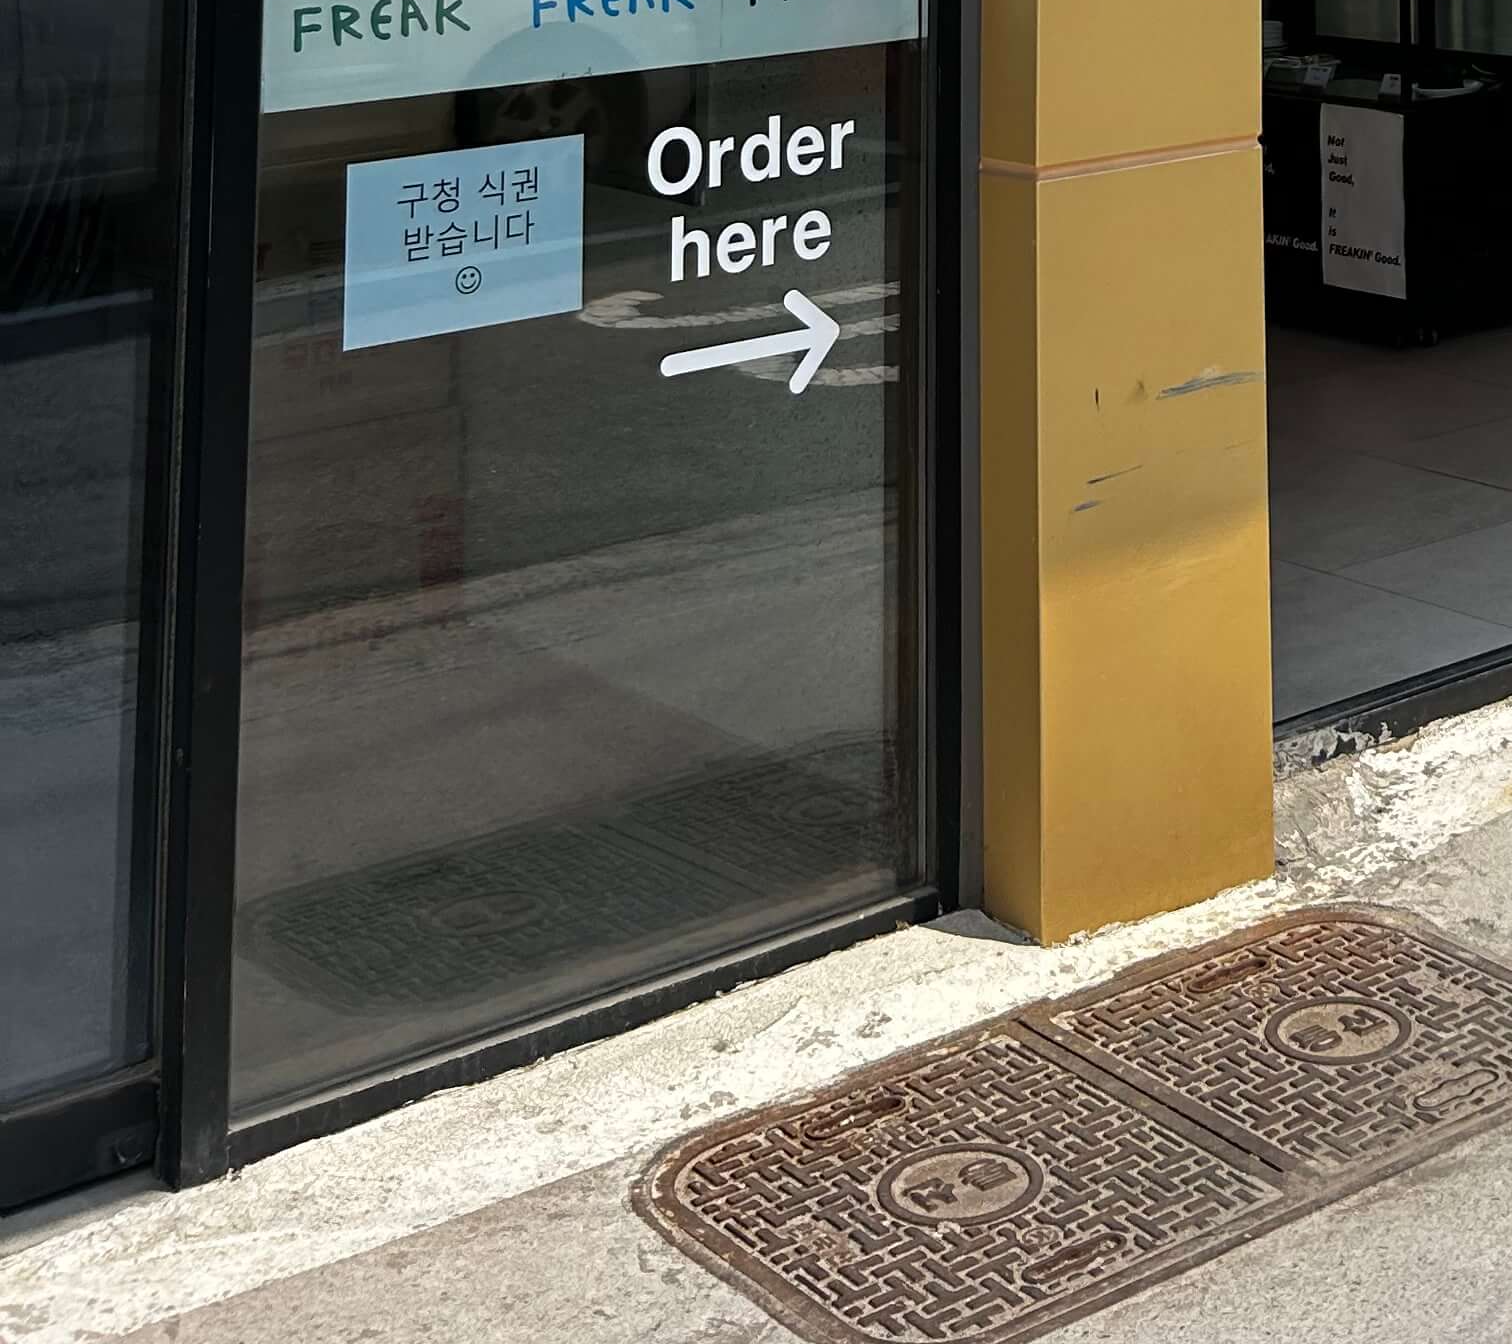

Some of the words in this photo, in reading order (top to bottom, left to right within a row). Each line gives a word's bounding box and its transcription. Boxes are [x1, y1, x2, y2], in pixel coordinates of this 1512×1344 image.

[648, 115, 854, 196] Order
[1328, 135, 1345, 148] Not
[1328, 152, 1348, 166] Just
[396, 177, 461, 219] 구청
[478, 166, 540, 203] 식권
[404, 214, 535, 262] 받습니다
[671, 210, 831, 282] here
